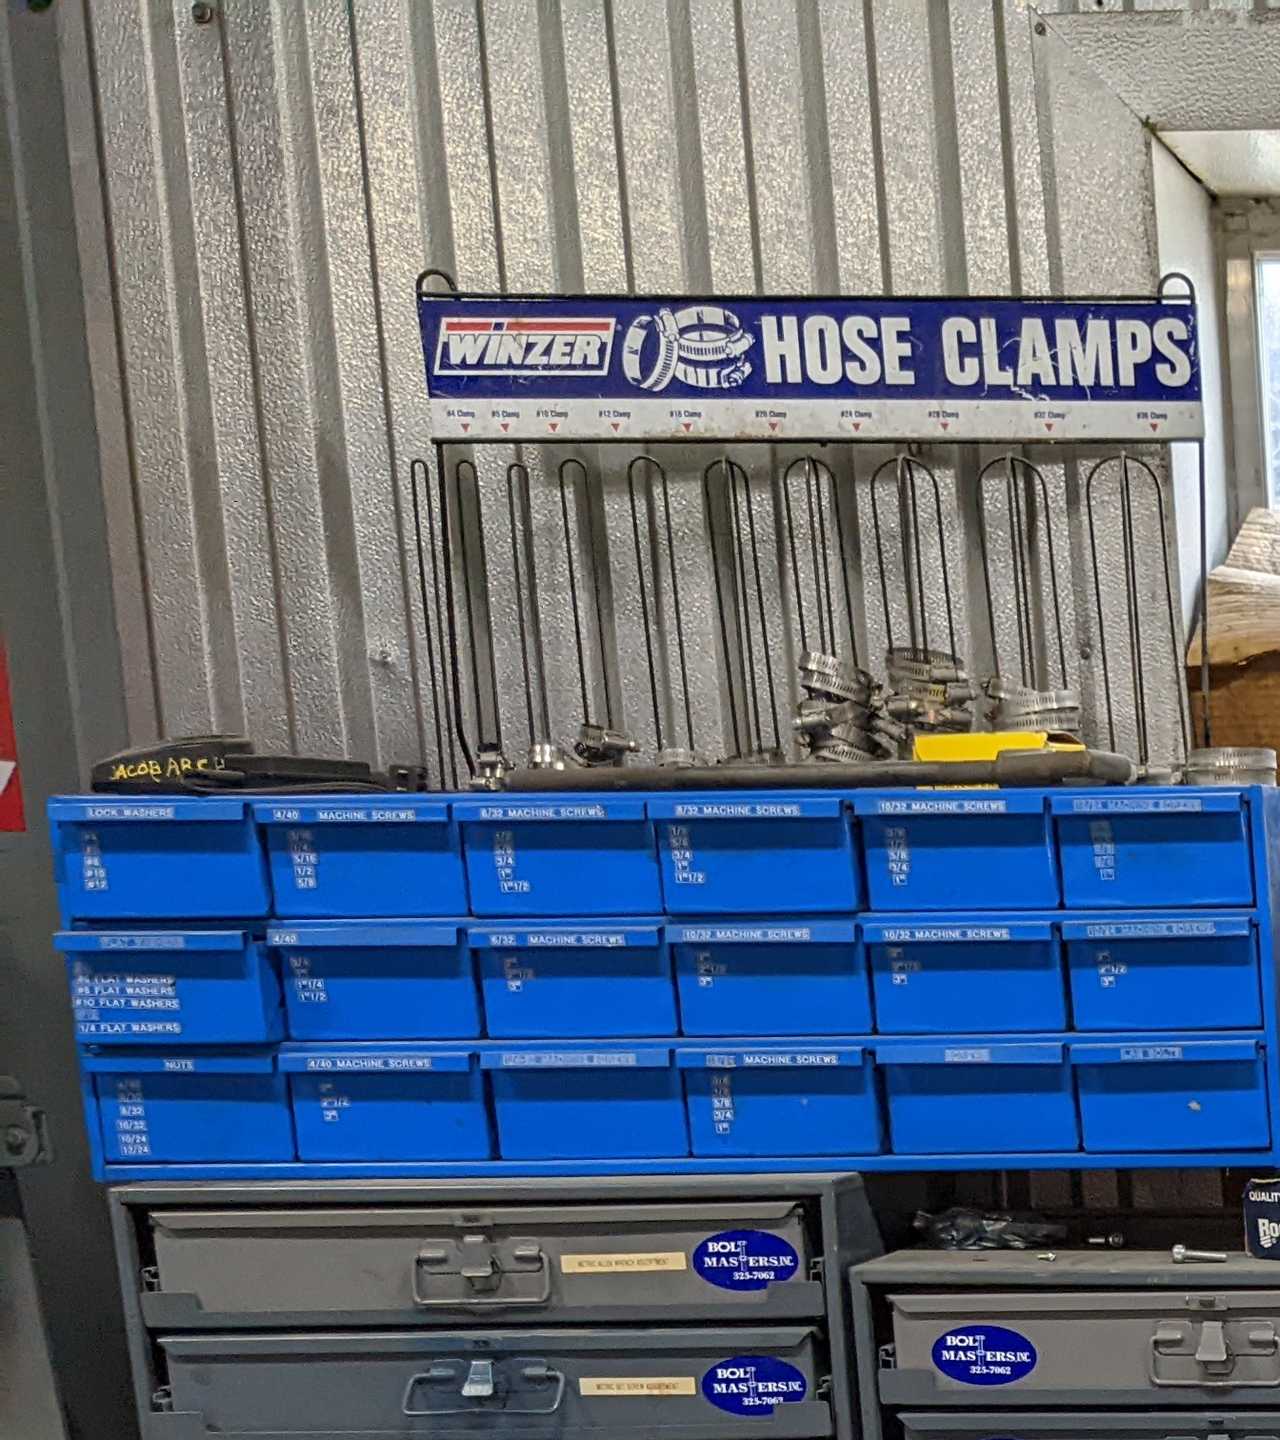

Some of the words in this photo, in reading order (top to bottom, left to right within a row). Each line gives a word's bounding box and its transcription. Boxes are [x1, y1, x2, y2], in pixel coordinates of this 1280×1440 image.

[448, 333, 602, 366] WINZER
[761, 315, 916, 385] HOSE
[941, 316, 1192, 388] CLAMPS
[733, 1271, 775, 1280] 325-7062
